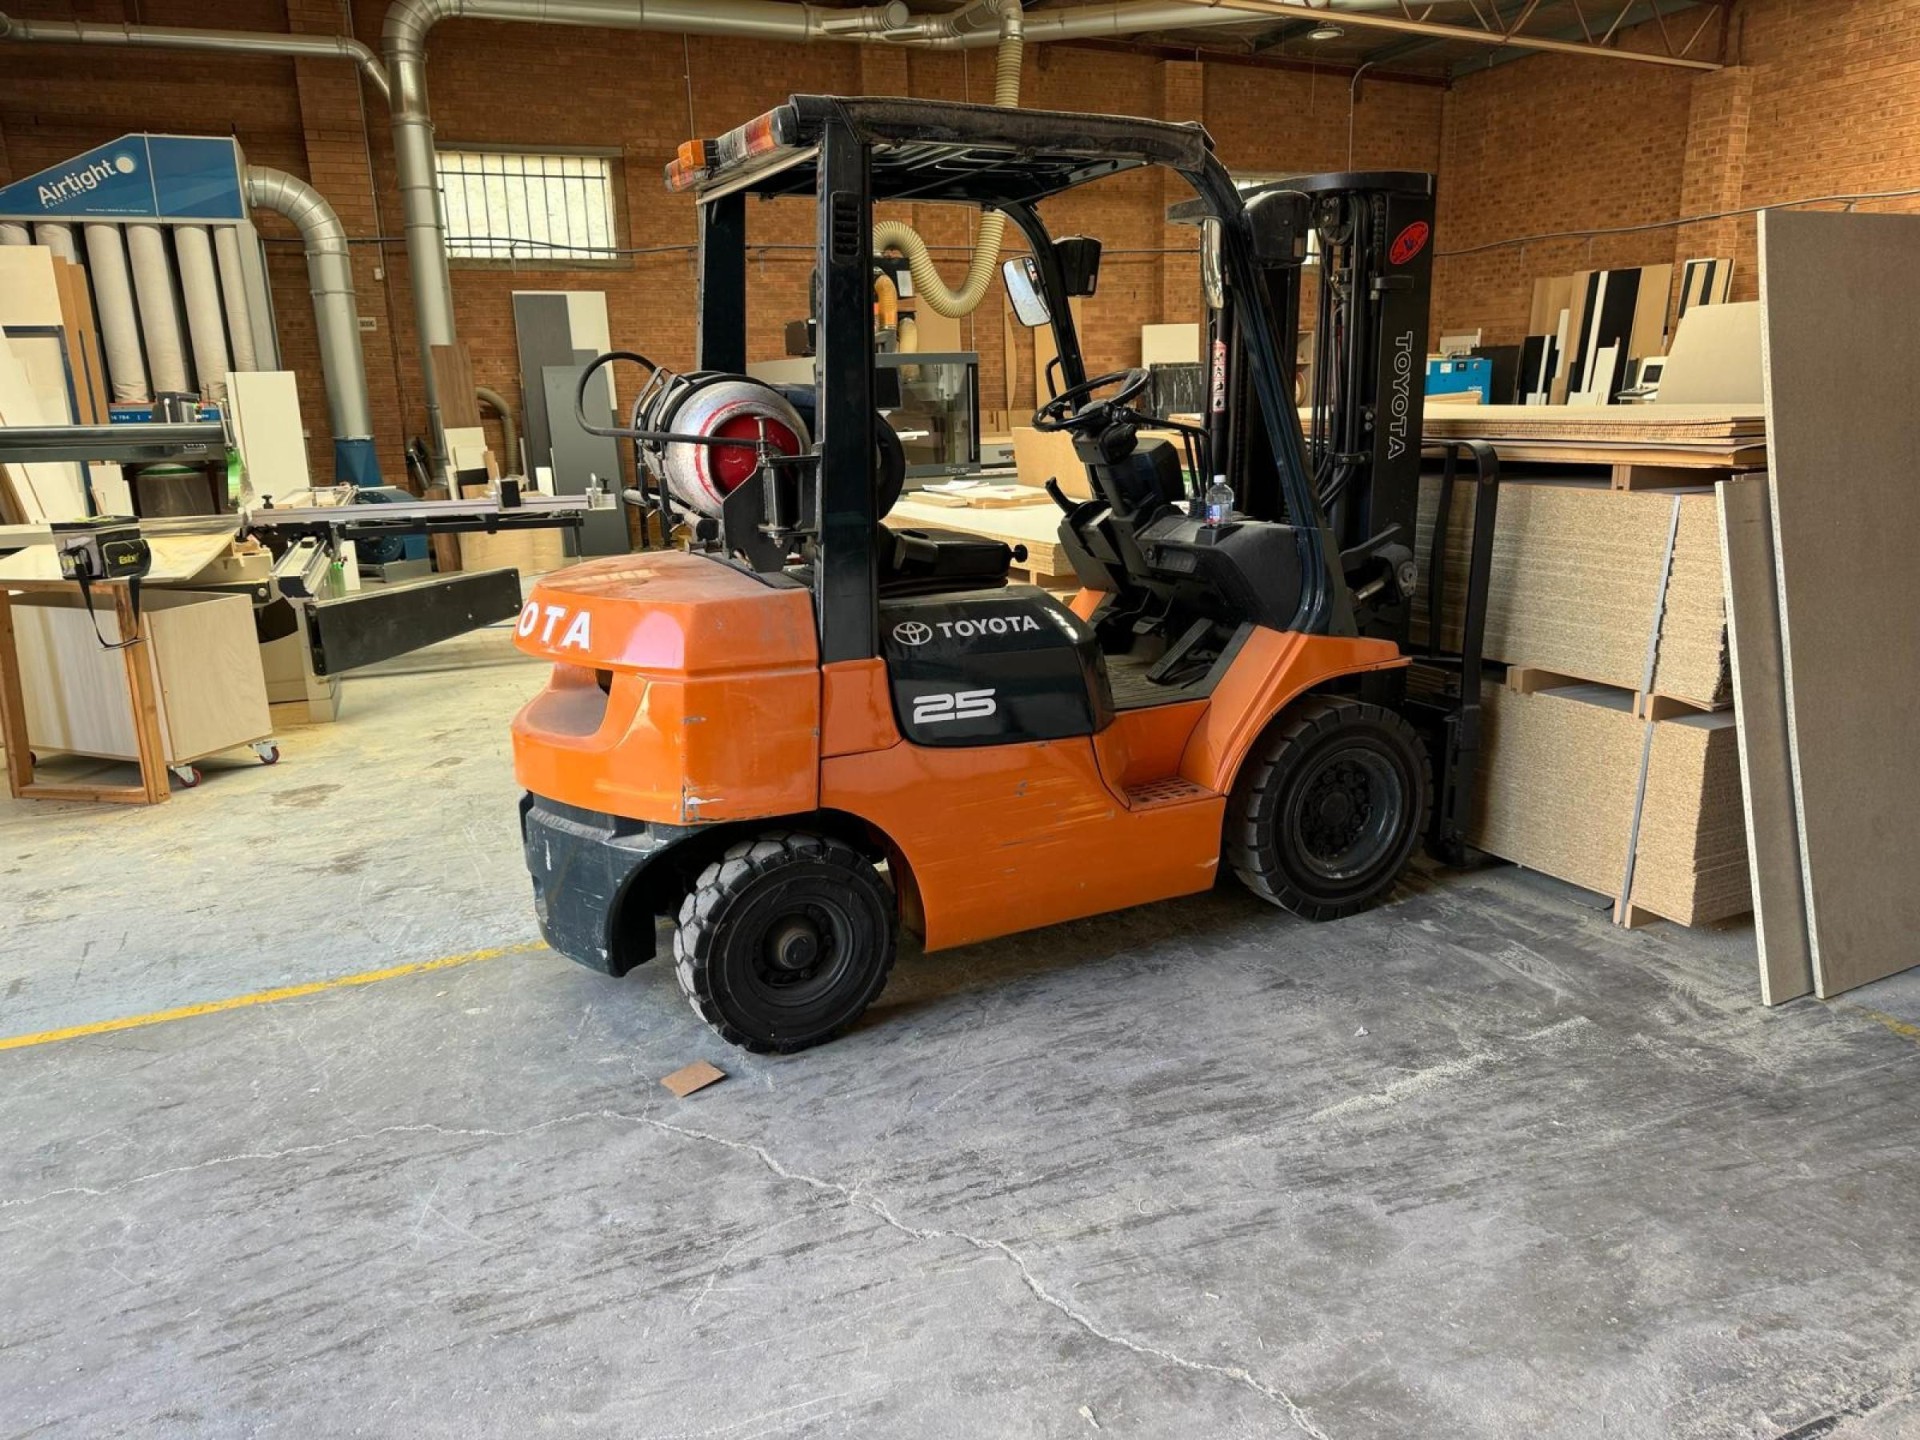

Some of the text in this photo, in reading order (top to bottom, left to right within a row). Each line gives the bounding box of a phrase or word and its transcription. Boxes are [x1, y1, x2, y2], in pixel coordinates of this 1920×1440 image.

[38, 159, 117, 205] Airtight
[1387, 330, 1413, 460] TOYOTA
[936, 614, 1040, 638] TOYOTA
[913, 688, 997, 724] 25
